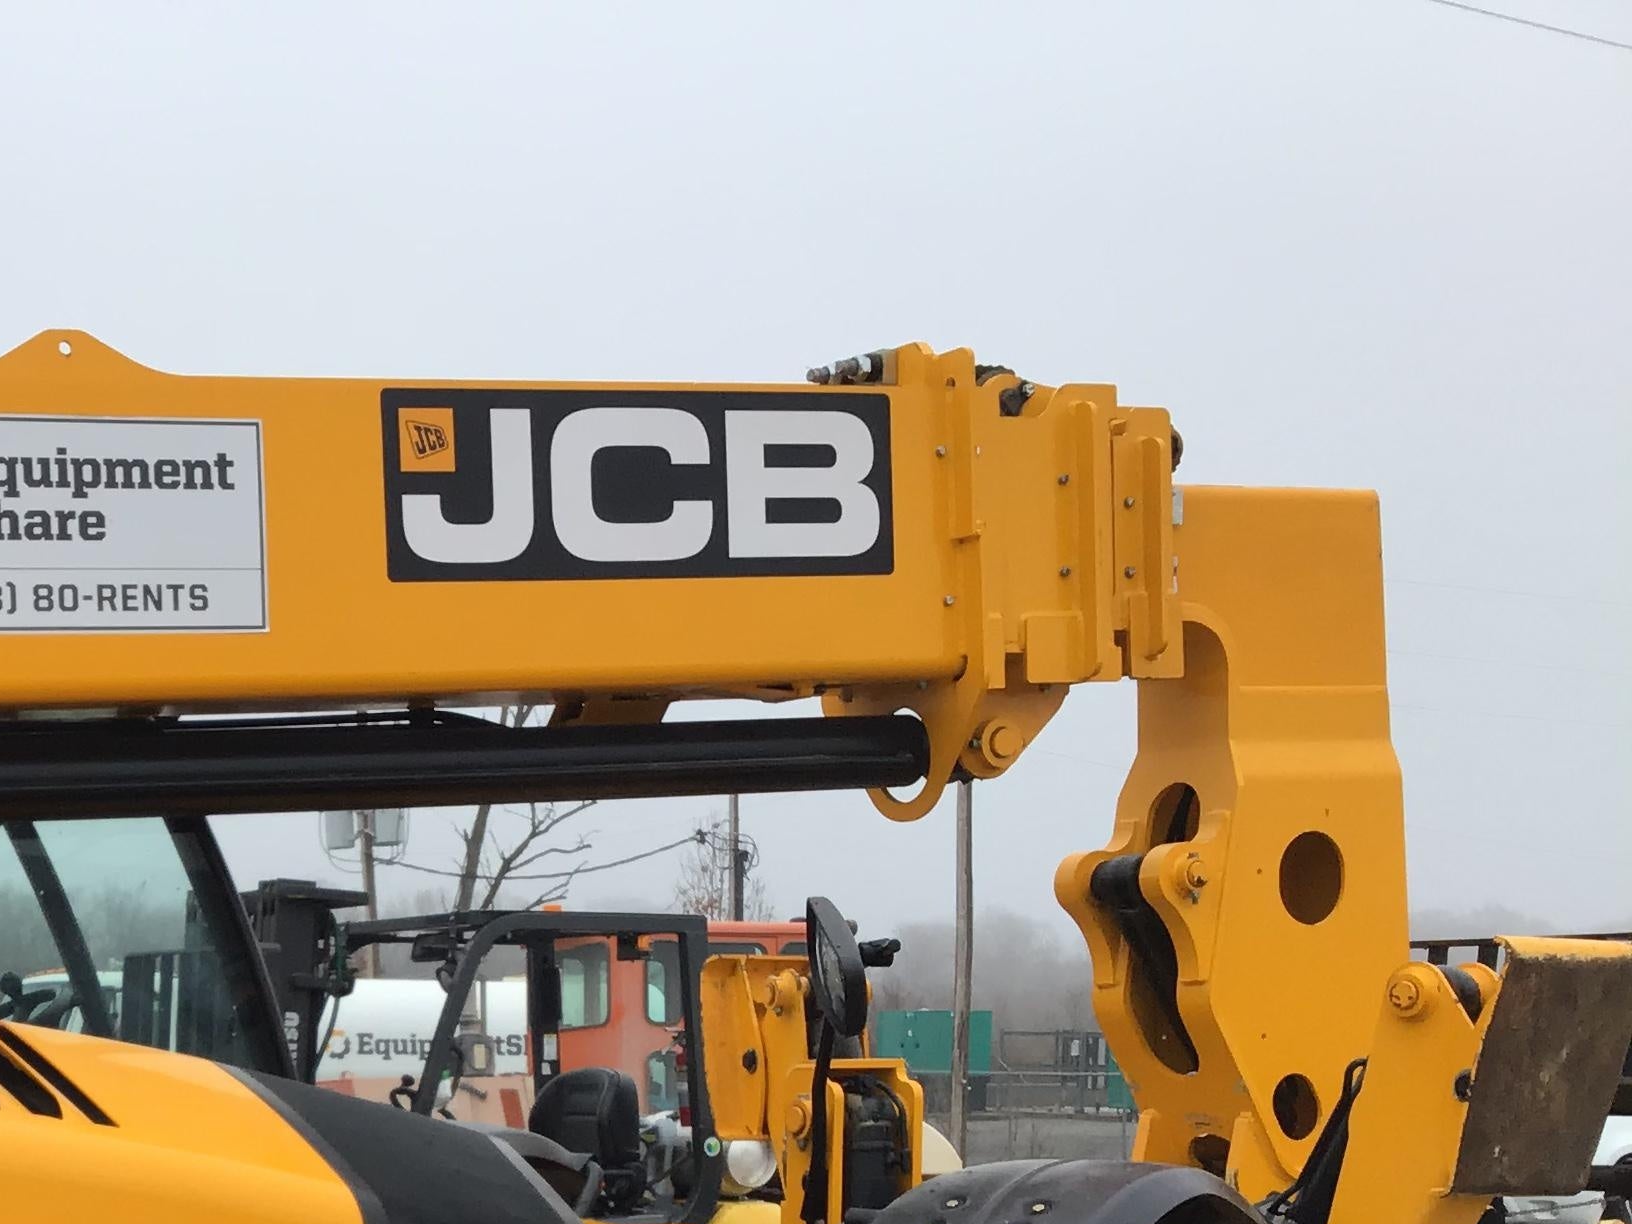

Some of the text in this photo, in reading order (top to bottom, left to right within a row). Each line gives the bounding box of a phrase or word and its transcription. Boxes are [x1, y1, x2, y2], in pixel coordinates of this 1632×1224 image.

[413, 424, 446, 455] JCB
[402, 406, 881, 565] JCB
[33, 582, 210, 612] 80-RENTS
